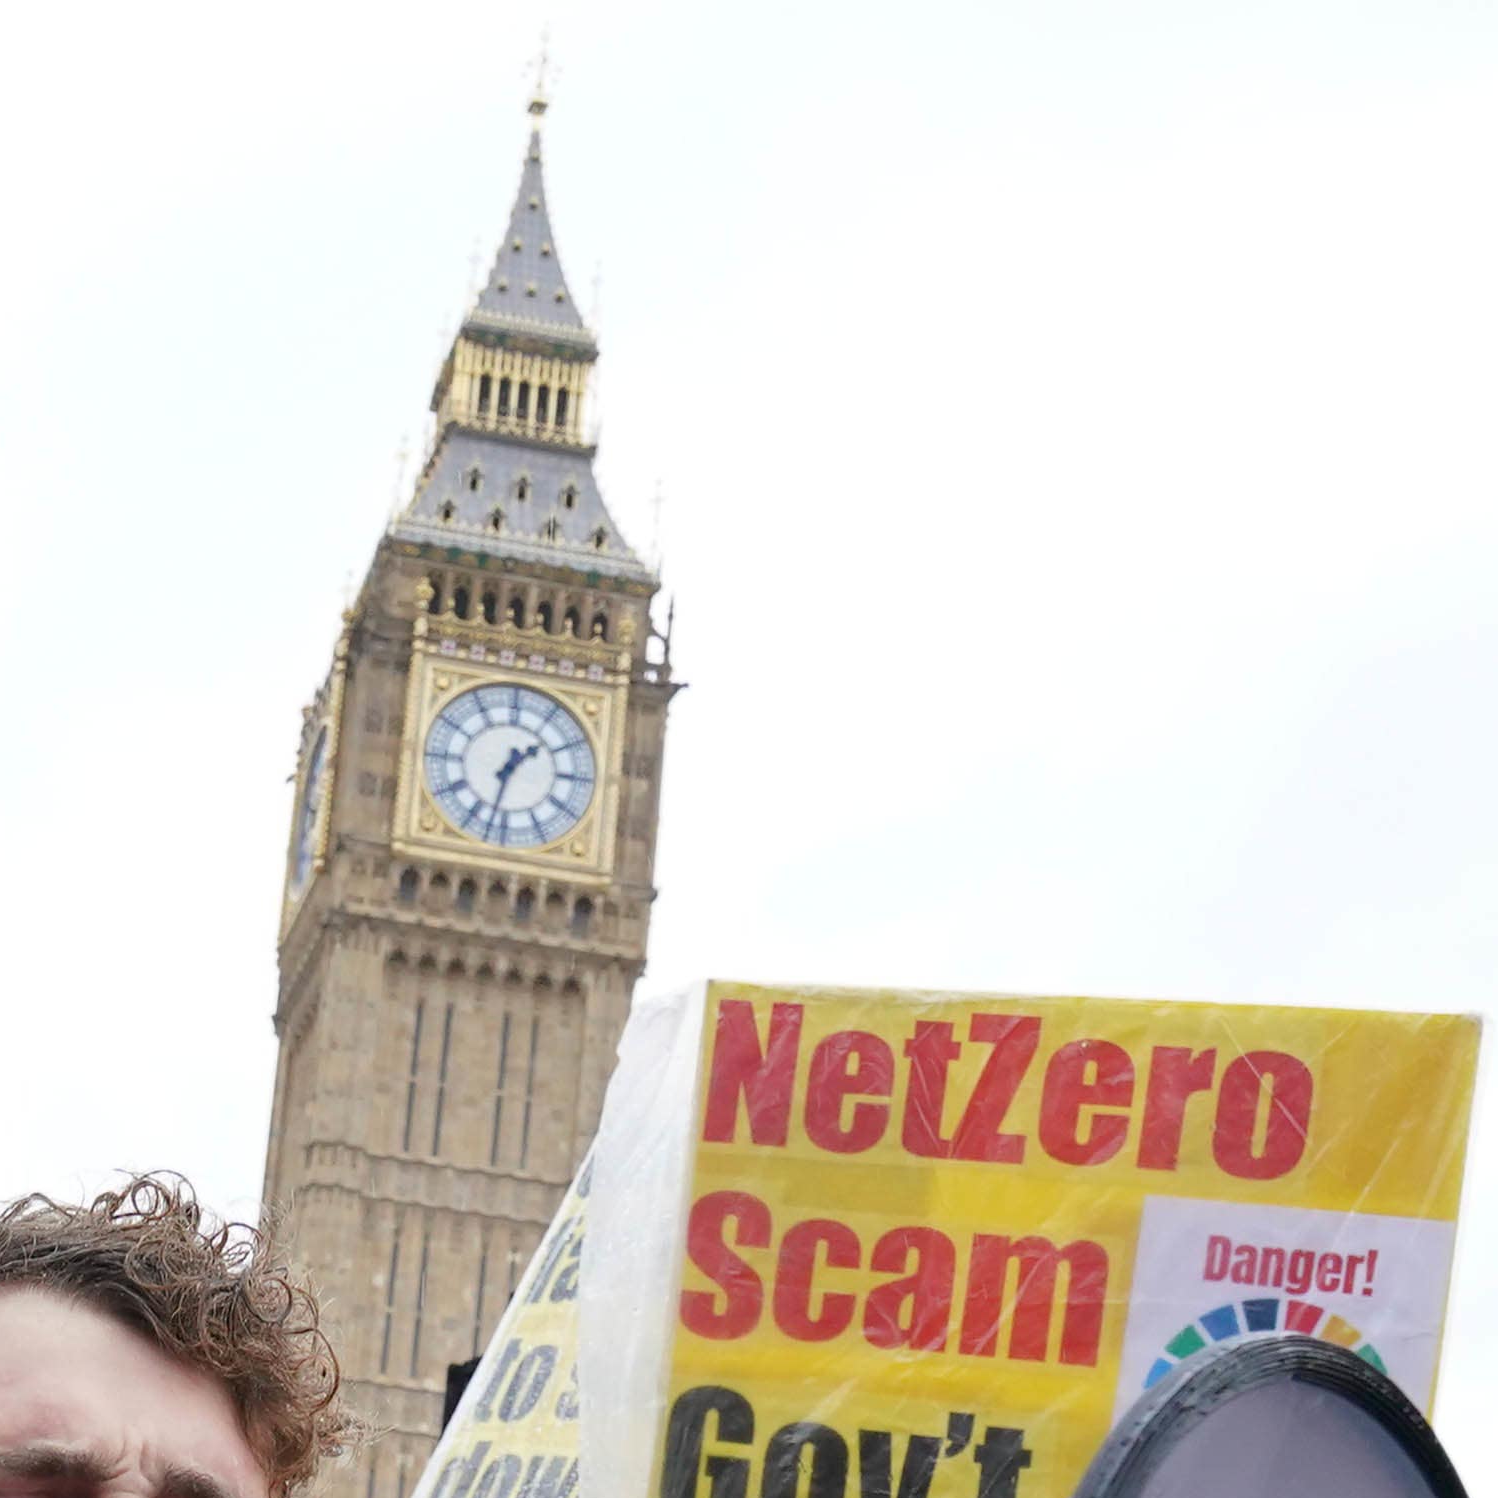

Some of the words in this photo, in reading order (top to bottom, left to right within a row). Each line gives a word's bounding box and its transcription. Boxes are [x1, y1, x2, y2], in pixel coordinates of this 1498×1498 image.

[702, 1001, 1315, 1181] NetZero
[679, 1191, 1110, 1367] Scam
[1203, 1235, 1378, 1297] Danger!
[474, 1338, 558, 1423] to
